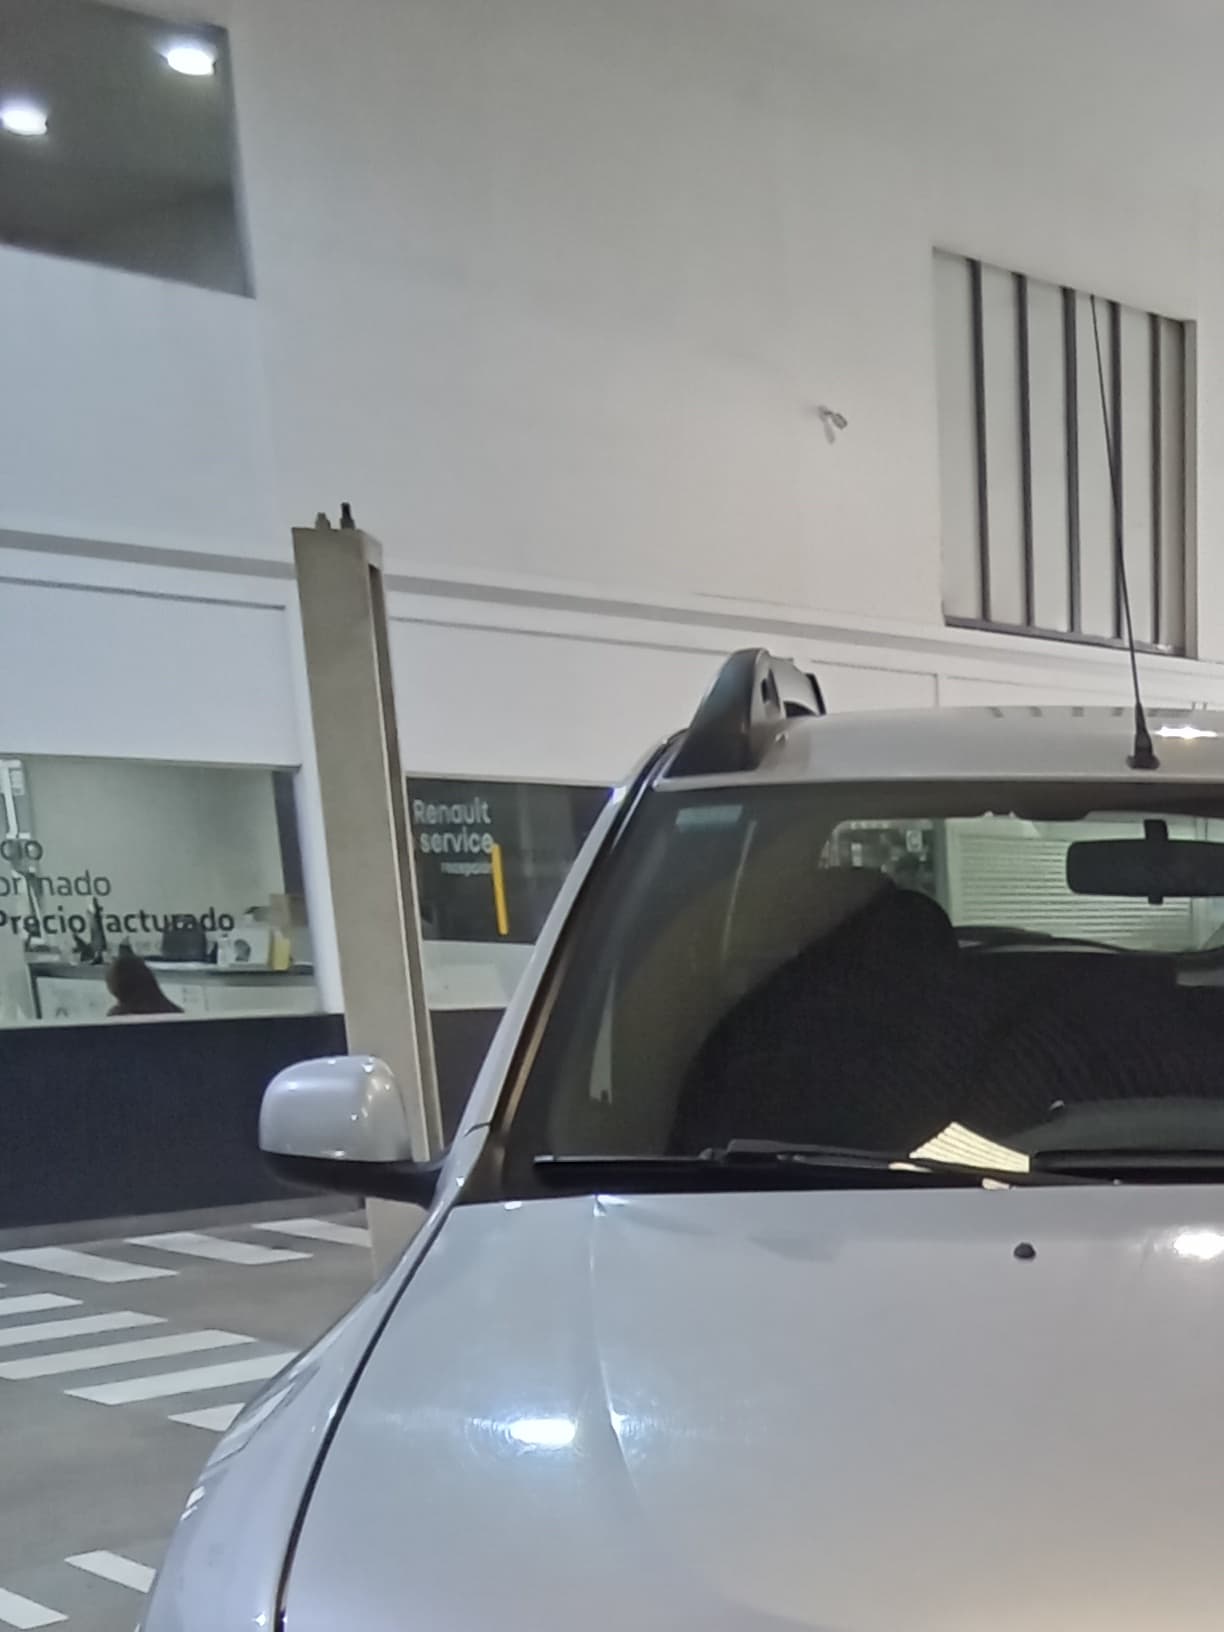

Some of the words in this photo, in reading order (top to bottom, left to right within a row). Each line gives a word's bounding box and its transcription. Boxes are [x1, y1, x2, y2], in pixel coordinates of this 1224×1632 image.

[413, 797, 491, 824] Renault
[420, 826, 495, 853] service
[94, 904, 235, 933] facturado
